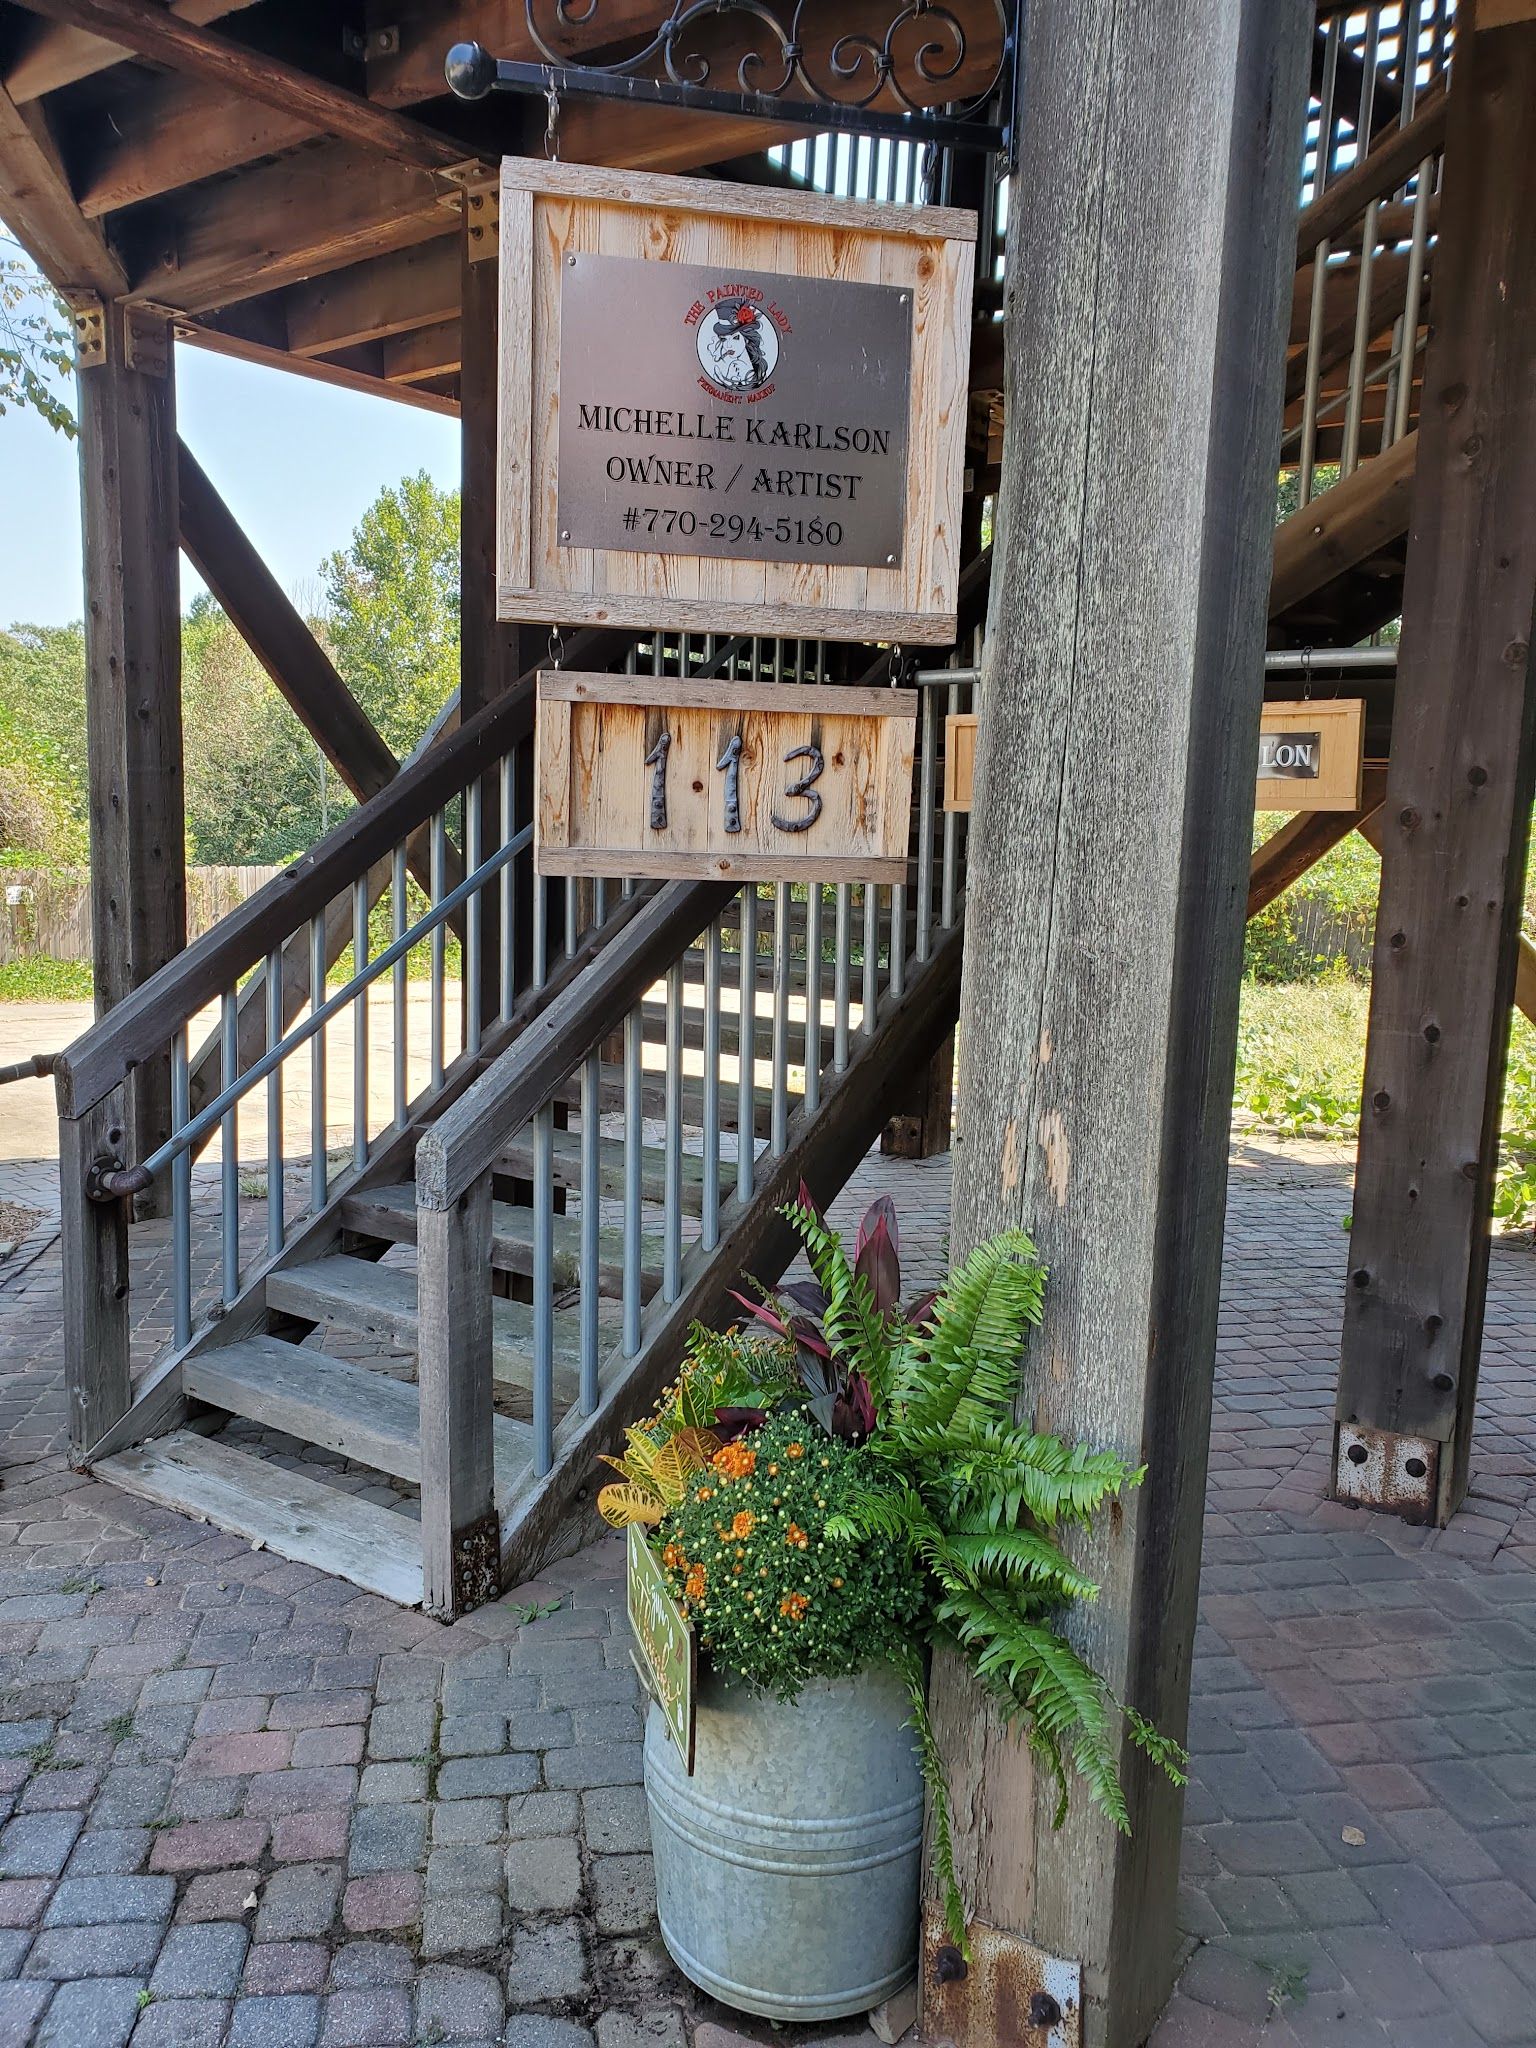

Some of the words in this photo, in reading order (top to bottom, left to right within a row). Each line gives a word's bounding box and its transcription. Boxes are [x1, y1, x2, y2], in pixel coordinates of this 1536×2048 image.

[684, 300, 706, 326] THE
[706, 284, 764, 303] PAINTED
[767, 301, 792, 334] LADY
[577, 404, 736, 442] MICHELLE
[745, 418, 890, 455] KARLSON
[606, 454, 716, 491] OWNER
[751, 468, 863, 500] ARTIST
[622, 507, 843, 546] #770-294-5180
